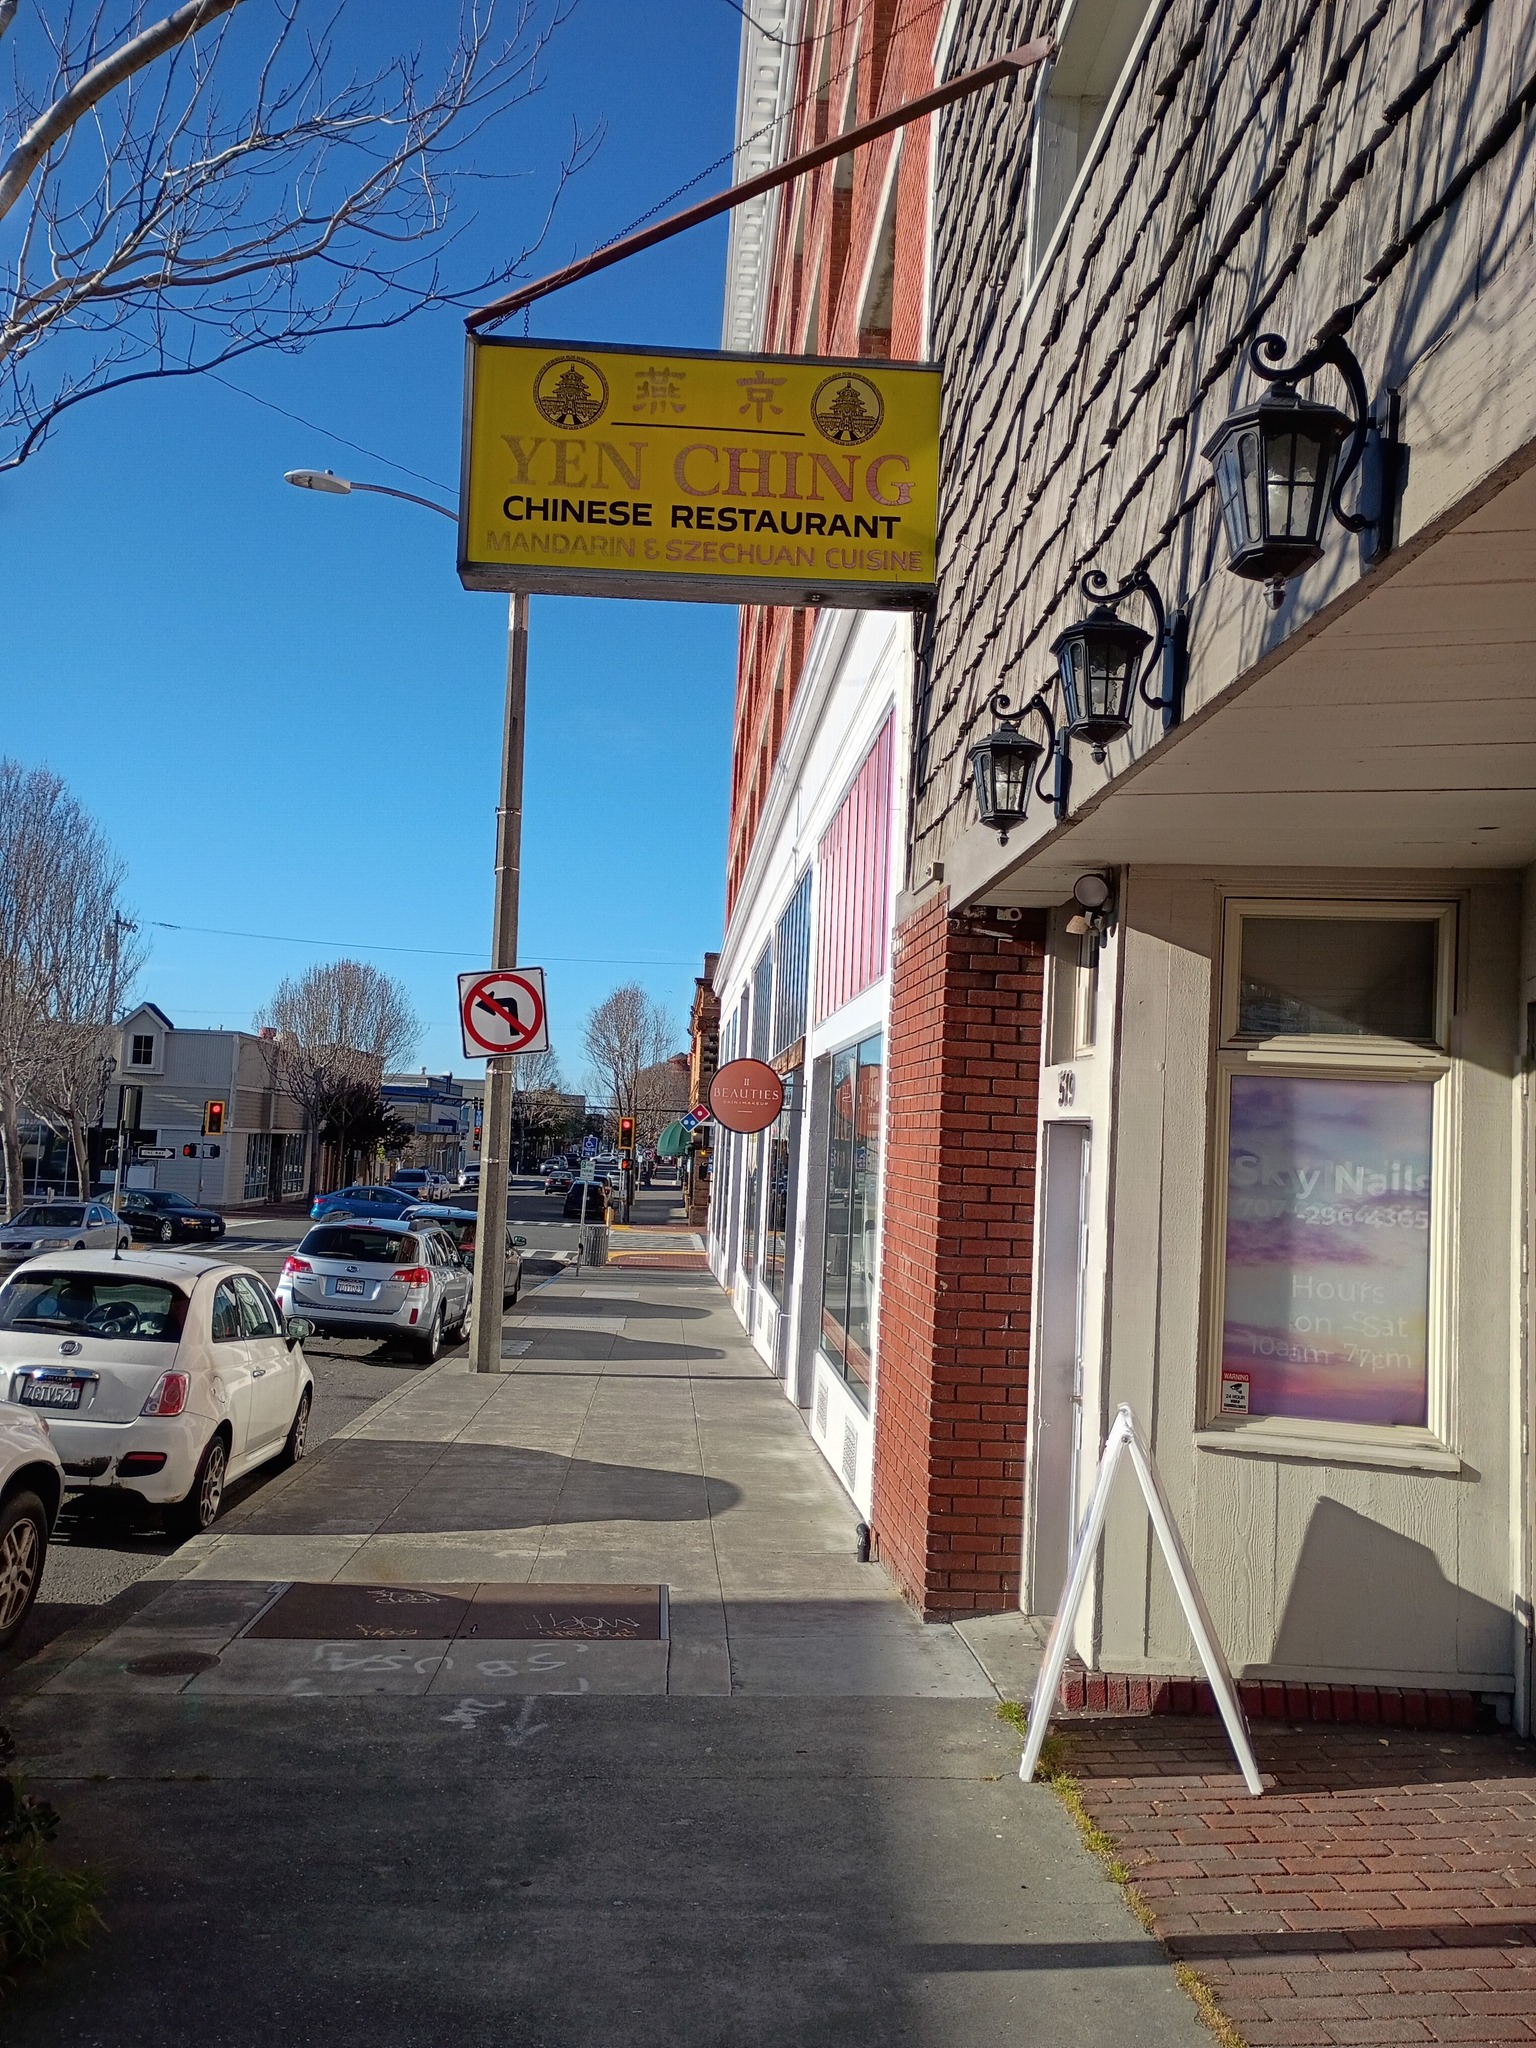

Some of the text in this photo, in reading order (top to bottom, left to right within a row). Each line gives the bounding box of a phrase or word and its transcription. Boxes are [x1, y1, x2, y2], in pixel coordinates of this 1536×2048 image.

[501, 435, 915, 506] YEN CHING
[503, 495, 901, 539] CHINESE RESTAURANT
[486, 529, 922, 571] MANDARIN & SZECHUAN CUISINE
[713, 1088, 779, 1100] BEAUTIES
[1234, 1155, 1428, 1199] Sky Nails
[1292, 1275, 1385, 1304] Hours
[1224, 1372, 1249, 1381] WARNING
